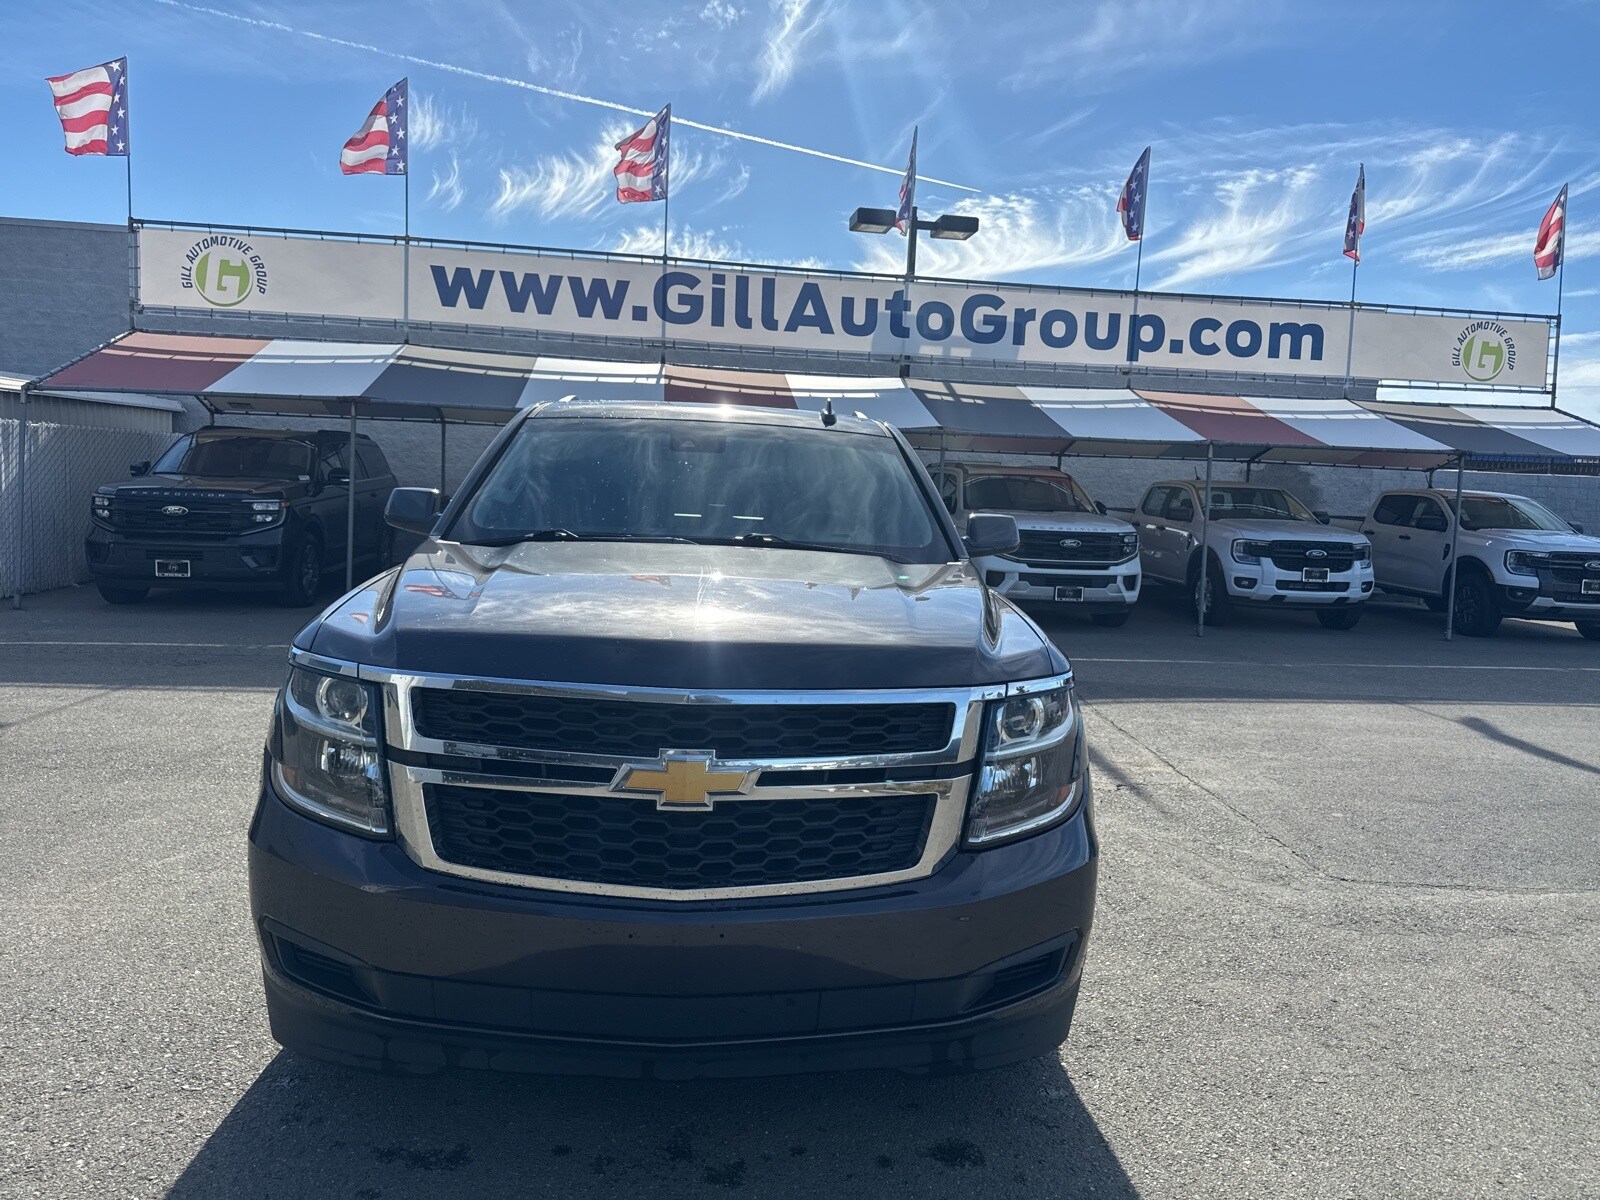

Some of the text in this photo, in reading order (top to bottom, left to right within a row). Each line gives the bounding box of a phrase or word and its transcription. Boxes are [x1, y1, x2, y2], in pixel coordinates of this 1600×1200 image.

[181, 235, 267, 294] GILL AUTOMOTIVE GROUP
[429, 264, 1325, 362] www.GillAutoGroup.com
[1451, 321, 1516, 370] GILL AUTOMOTIVE GROUP
